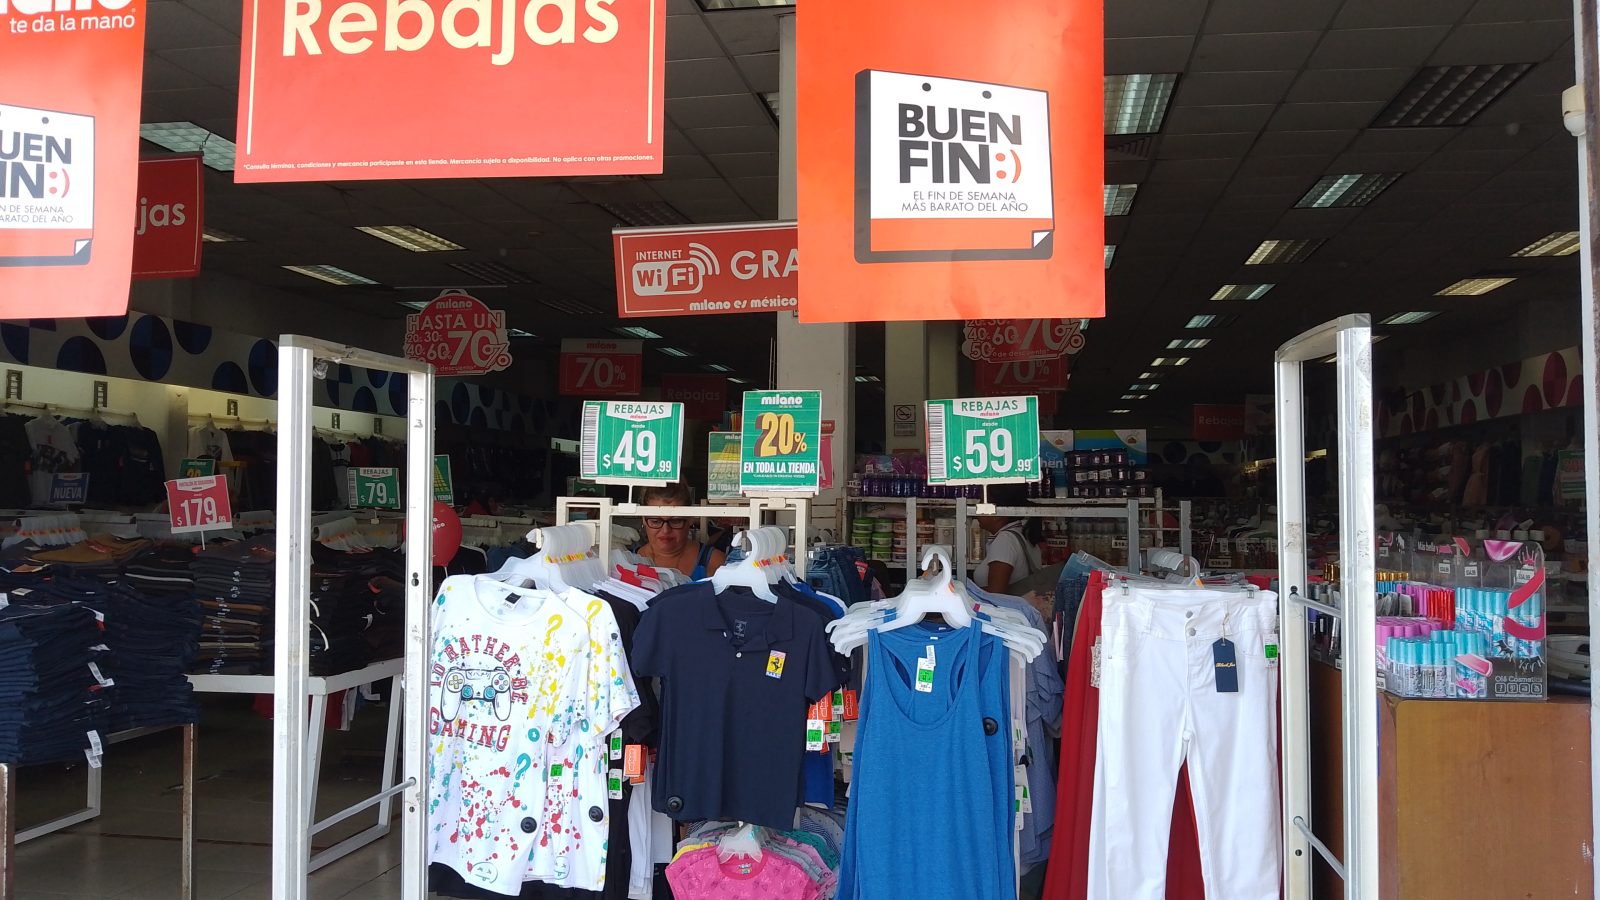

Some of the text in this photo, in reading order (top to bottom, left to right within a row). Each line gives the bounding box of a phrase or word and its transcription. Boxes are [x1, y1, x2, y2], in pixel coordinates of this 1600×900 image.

[9, 14, 135, 33] te da la mano
[281, 0, 619, 66] Rebajas
[898, 102, 1022, 145] BUEN
[913, 191, 1017, 201] EL FIN DE SEMANA
[9, 204, 22, 213] DE
[24, 205, 65, 214] SEMANA
[901, 200, 1029, 212] MÁS BARATO DEL AÑO
[32, 214, 48, 224] DEL
[50, 212, 74, 224] AÑO
[635, 249, 683, 261] INTERNET
[435, 298, 473, 309] milano
[689, 294, 798, 312] milano es méxico
[408, 312, 502, 331] HASTA UN
[575, 357, 626, 388] 70%
[666, 388, 721, 403] Rebajas
[761, 394, 803, 405] milano
[614, 404, 665, 415] REBAJAS
[961, 399, 1019, 412] REBAJAS
[754, 411, 807, 458] 20%
[743, 461, 816, 474] EN TODA LA TIENDA
[53, 487, 82, 499] NUEVA
[443, 634, 521, 672] RATHER
[511, 676, 529, 705] BE
[429, 706, 512, 752] GAMING
